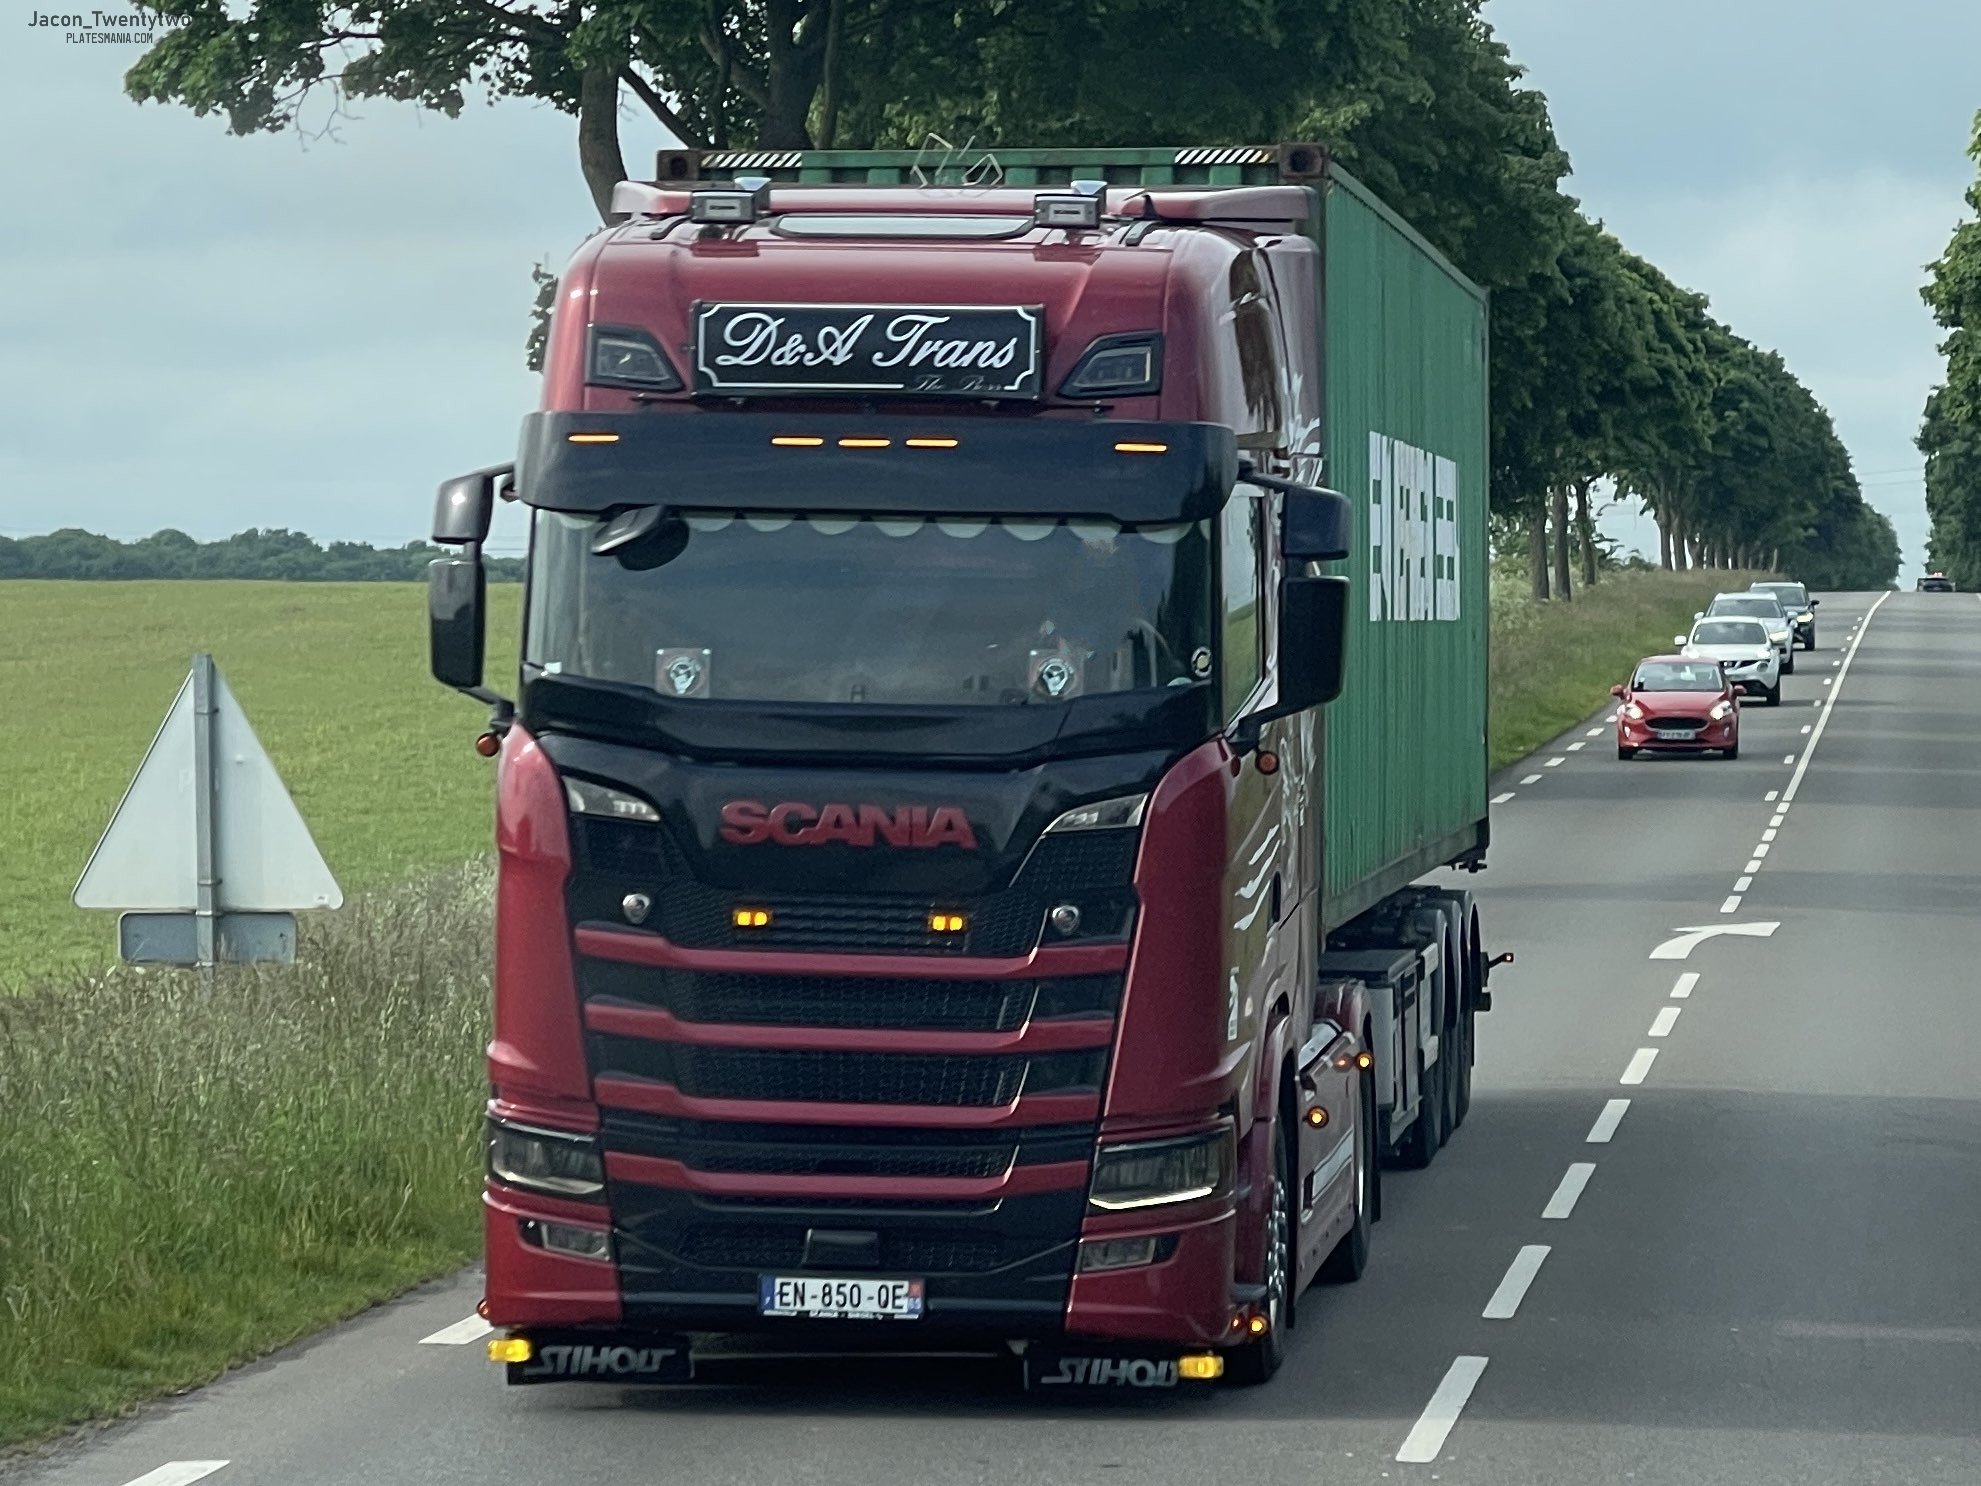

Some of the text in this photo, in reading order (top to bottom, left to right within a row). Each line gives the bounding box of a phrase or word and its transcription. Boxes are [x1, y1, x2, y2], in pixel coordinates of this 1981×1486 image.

[715, 312, 1018, 368] D&A Trans
[720, 799, 979, 849] SCANIA
